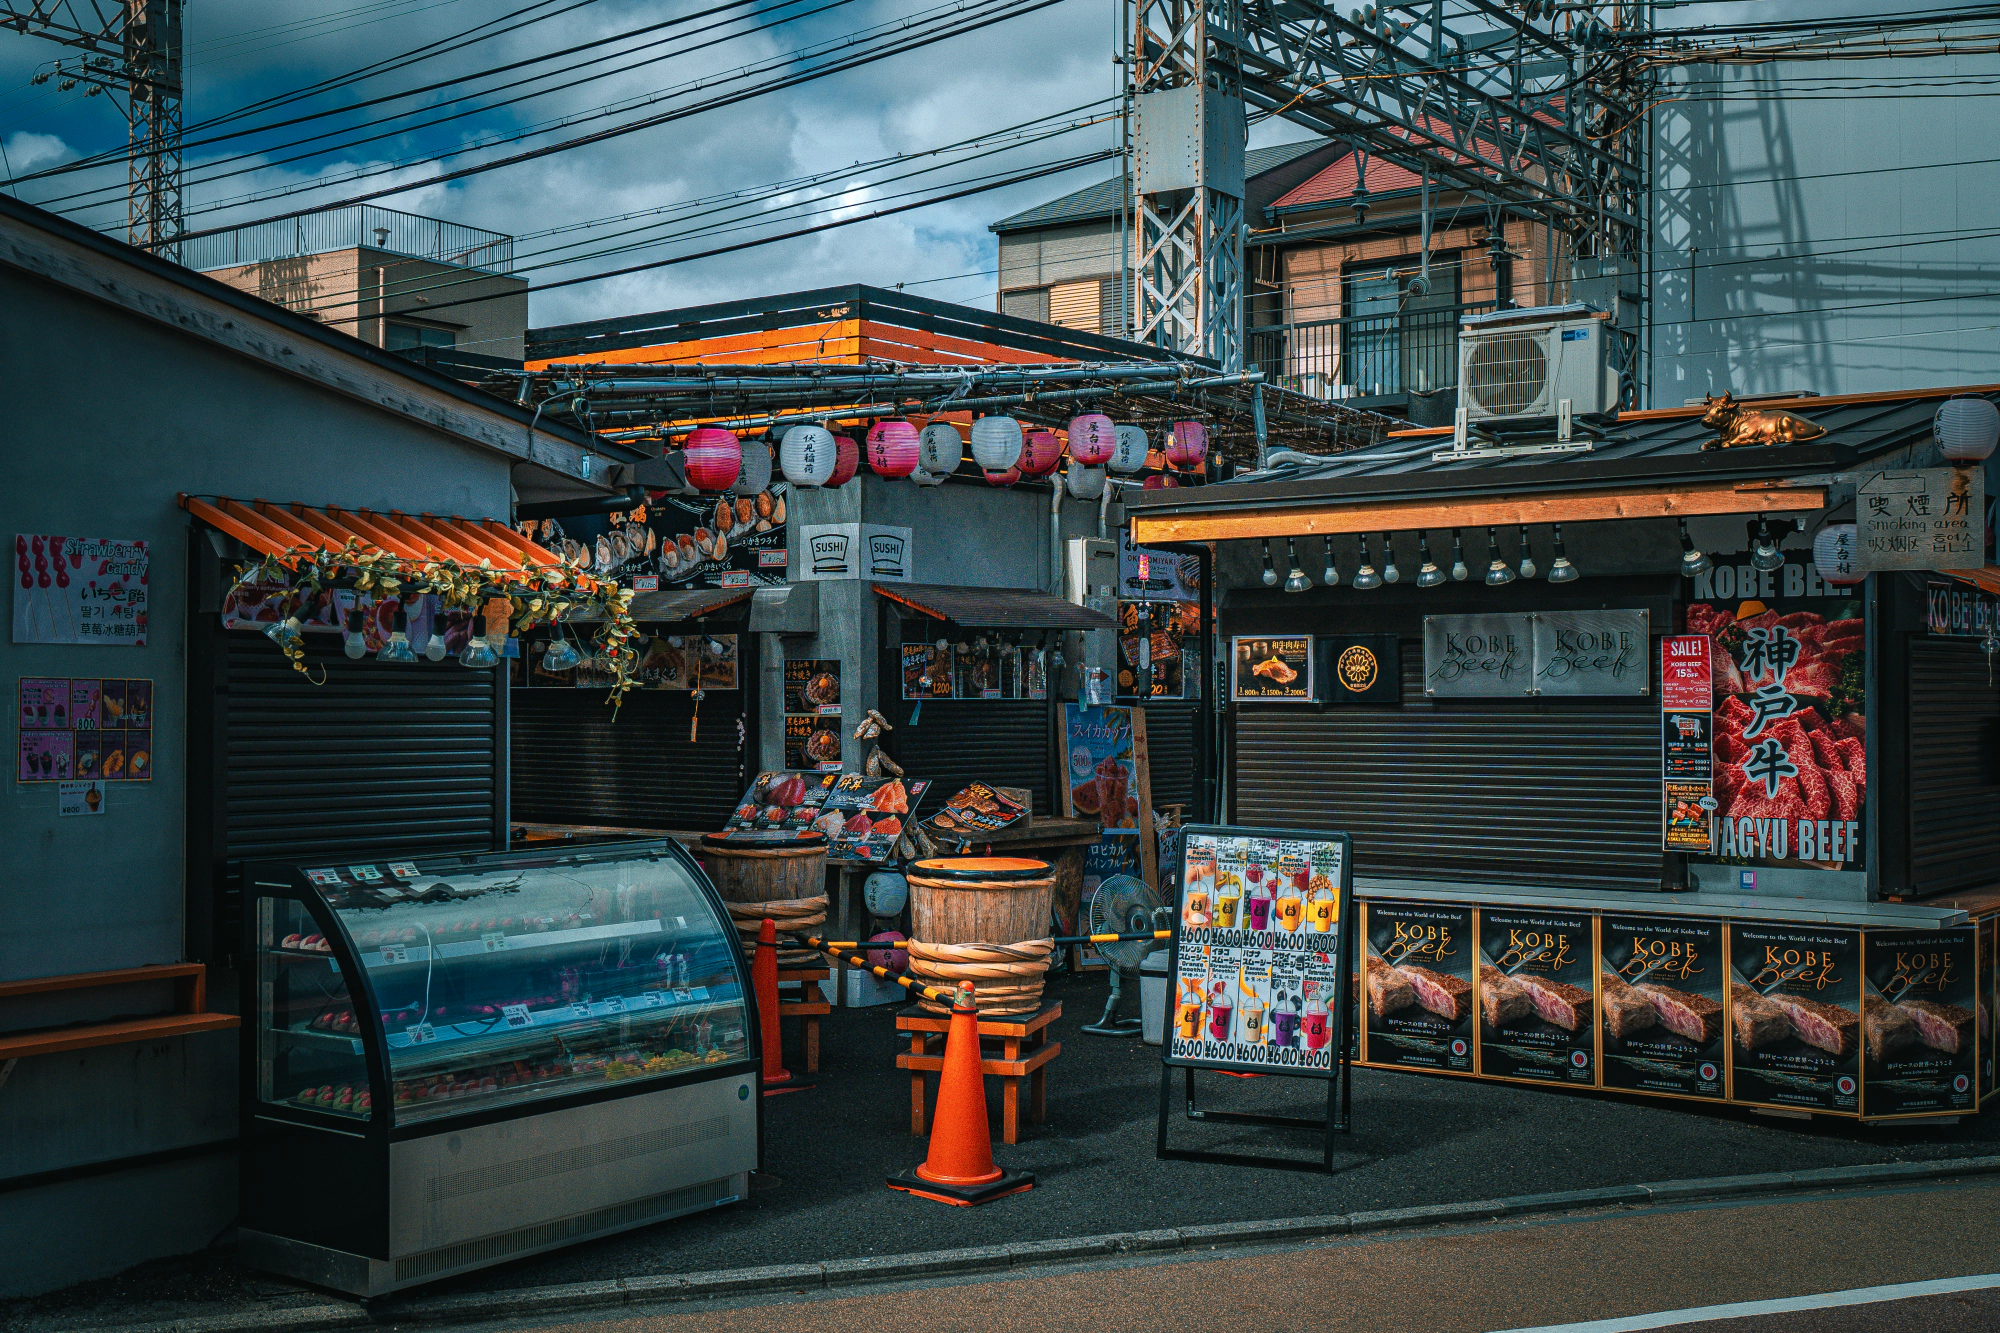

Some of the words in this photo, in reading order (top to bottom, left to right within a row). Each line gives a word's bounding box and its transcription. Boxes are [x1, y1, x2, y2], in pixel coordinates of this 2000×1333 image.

[926, 430, 937, 462] 伏見稲荷
[1087, 421, 1100, 455] 屋台村
[1121, 432, 1131, 464] 伏見稲荷
[803, 435, 815, 473] 伏見稲荷
[875, 431, 887, 467] 屋台村
[1025, 439, 1034, 468] 屋台村
[1868, 490, 1972, 517] 喫煙所
[1934, 520, 1969, 529] area
[65, 538, 148, 560] Strawberry
[816, 542, 843, 552] SUSHI
[874, 542, 899, 554] SUSHI
[1834, 533, 1851, 574] 屋台村
[106, 559, 148, 577] candy
[1128, 554, 1176, 565] OKOMIYAKI
[1694, 565, 1775, 599] KOBE
[81, 588, 145, 602] いちご飴
[81, 605, 104, 618] 딸기
[111, 606, 134, 619] 사탕
[81, 623, 146, 636] 草莓冰糖葫芦
[1272, 640, 1307, 650] 和牛肉寿司
[1446, 633, 1516, 653] KOBE
[1554, 629, 1630, 651] KOBE
[1671, 640, 1702, 656] SALE!
[1429, 646, 1527, 679] Beef
[1537, 644, 1641, 678] Beef
[643, 667, 677, 680] 本まぐろ
[786, 670, 811, 680] すき焼き
[1741, 625, 1801, 799] 神戸牛
[78, 719, 95, 729] 800
[786, 726, 812, 736] すき焼き
[1072, 723, 1130, 740] スイカカップ
[1088, 845, 1127, 856] ロピカル
[1281, 840, 1305, 848] マンゴー
[1798, 819, 1858, 862] BEEF
[1280, 849, 1309, 857] スムージー
[1181, 926, 1210, 944] ¥600
[1212, 929, 1242, 946] ¥600
[1243, 931, 1273, 948] ¥600
[1275, 933, 1304, 950] ¥600
[1306, 935, 1337, 953] ¥600
[1394, 921, 1448, 941] KOBE
[1509, 929, 1567, 948] KOBE
[1180, 945, 1203, 953] オレンジ
[1382, 936, 1457, 961] Beef
[1496, 943, 1576, 970] Beef
[1633, 937, 1694, 957] KOBE
[1765, 946, 1831, 967] KOBE
[1212, 956, 1240, 964] スムージー
[1242, 958, 1271, 966] スムージー
[1272, 960, 1302, 968] スムージー
[1304, 962, 1333, 970] スムージー
[1619, 951, 1704, 980] Beef
[1896, 952, 1951, 971] KOBE
[1750, 960, 1842, 990] Beef
[1881, 963, 1959, 993] Beef
[1173, 1038, 1203, 1057] ¥600
[1205, 1041, 1234, 1059] ¥600
[1236, 1043, 1267, 1062] ¥600
[1268, 1047, 1298, 1065] ¥600
[1299, 1050, 1330, 1067] ¥600
